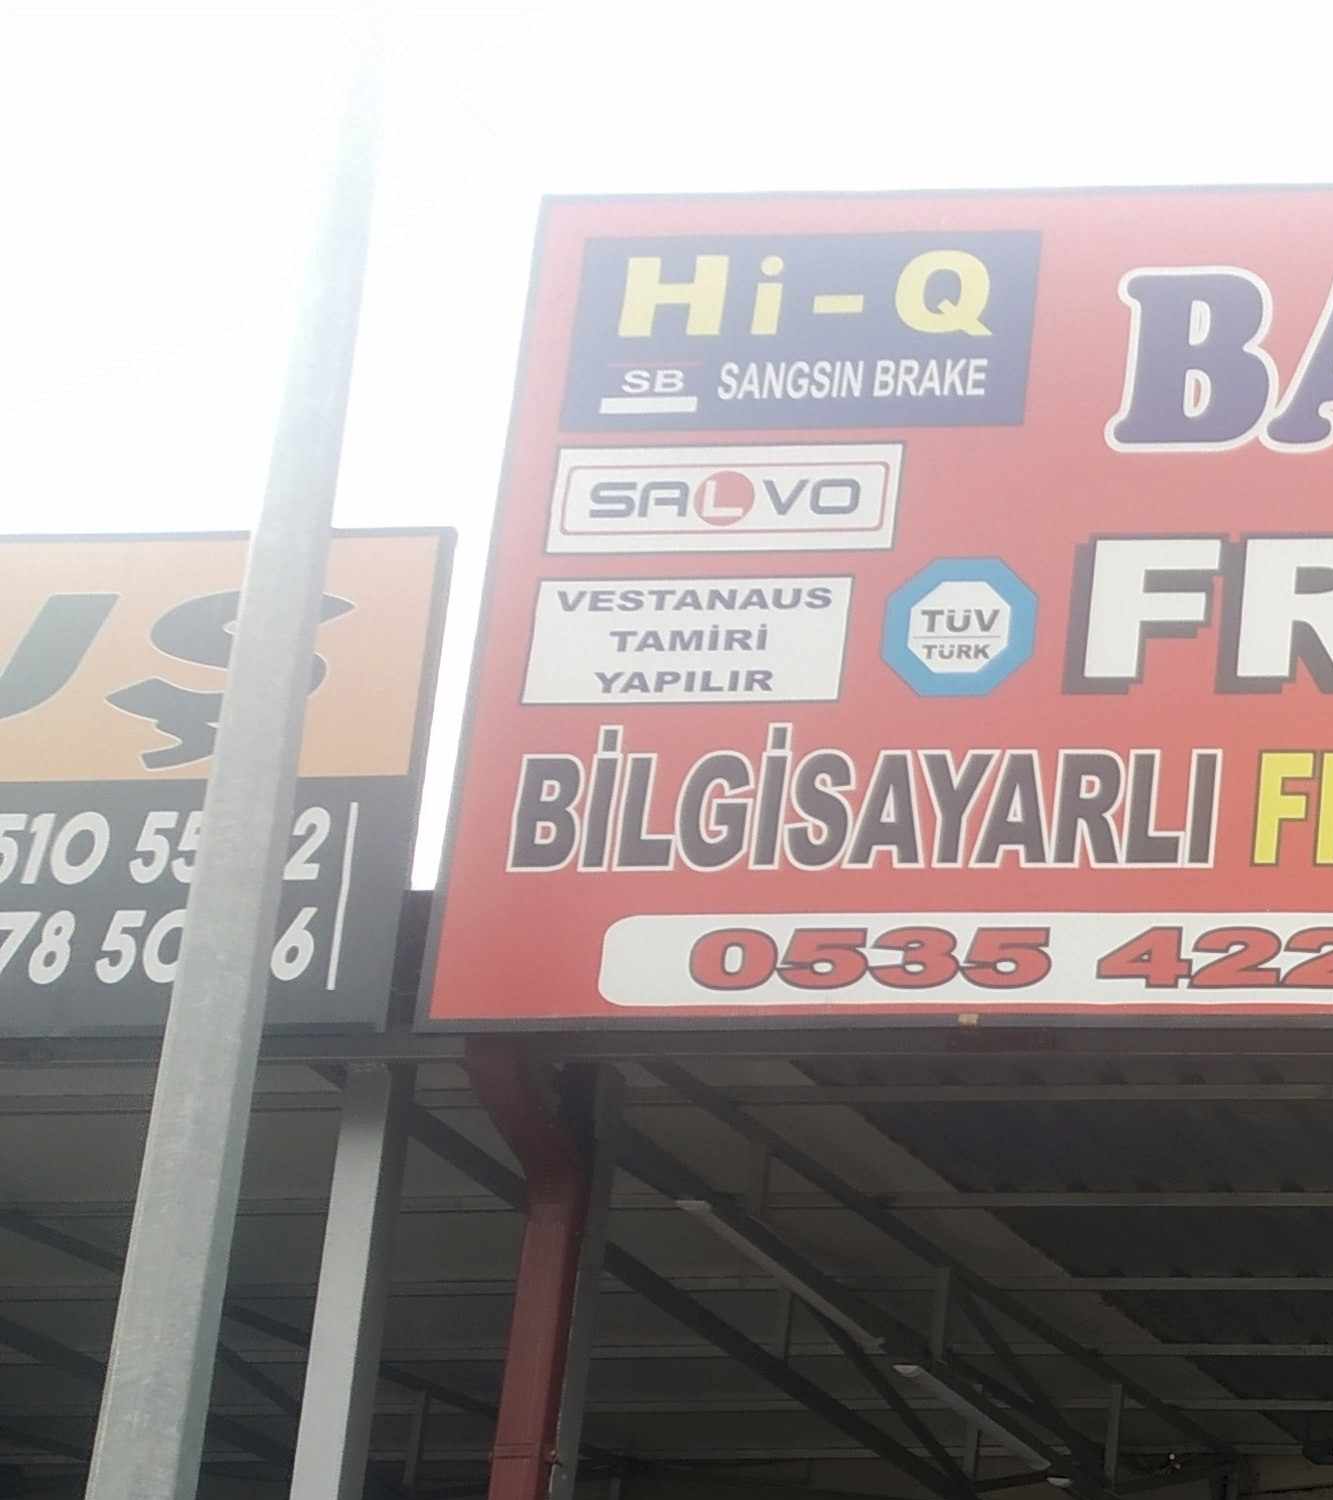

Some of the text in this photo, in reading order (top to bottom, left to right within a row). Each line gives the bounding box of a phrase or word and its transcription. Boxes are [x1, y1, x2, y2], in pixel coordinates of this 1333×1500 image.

[617, 250, 992, 338] Hi-Q
[621, 369, 685, 394] SB
[717, 358, 987, 401] SANGSIN BRAKE
[588, 471, 861, 526] SALVO
[556, 585, 832, 613] VESTANAUS
[922, 606, 1000, 634] TÜV
[609, 622, 769, 653] TAMİRİ
[922, 640, 991, 662] TÜRK
[595, 668, 773, 695] YAPILIR
[507, 722, 1222, 872] BİLGİSAYARLI
[689, 926, 1052, 990] 0535
